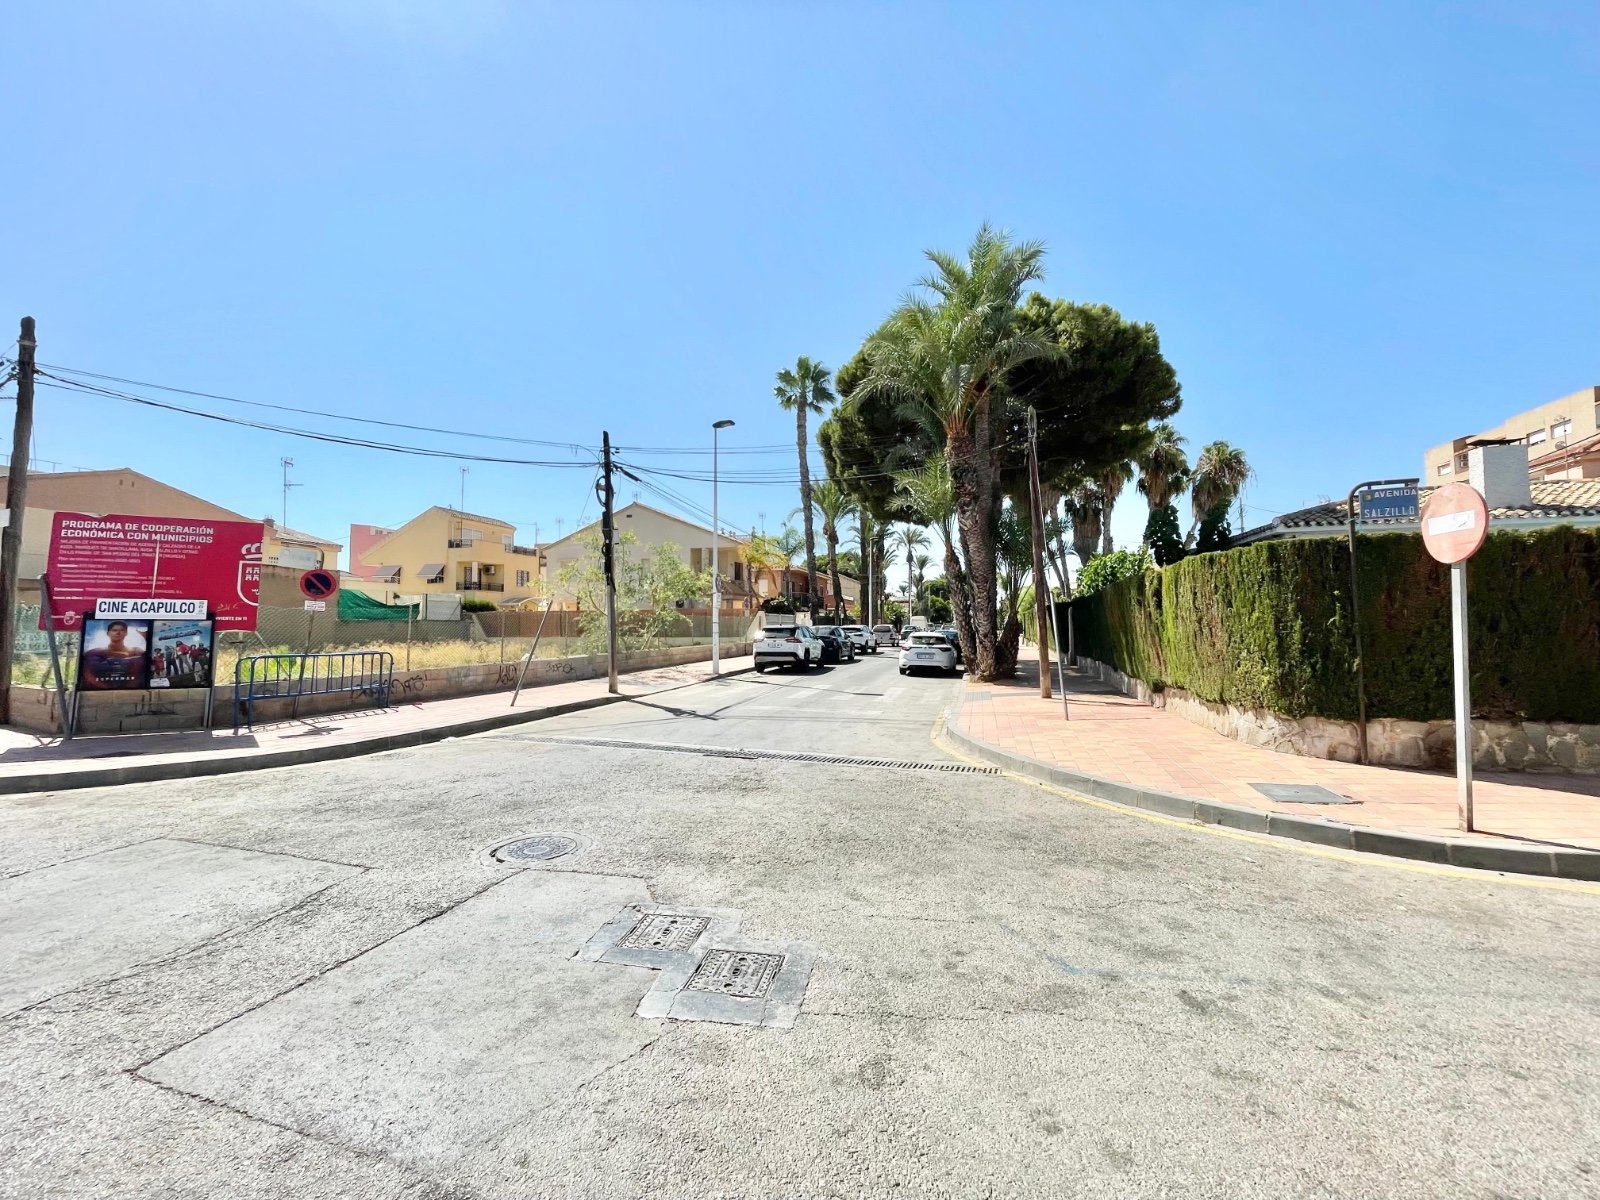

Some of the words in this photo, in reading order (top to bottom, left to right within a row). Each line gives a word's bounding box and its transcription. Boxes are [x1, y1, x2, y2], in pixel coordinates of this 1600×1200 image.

[1374, 489, 1417, 498] AVENIDA
[1364, 506, 1415, 518] SALZILLO
[62, 520, 122, 530] PROGRAMA
[125, 523, 139, 531] DE
[141, 523, 214, 535] COOPERACIÓN
[61, 528, 124, 539] ECONÓMICA
[127, 532, 149, 541] CON
[151, 533, 213, 544] MUNICIPIOS
[98, 601, 128, 613] CINE
[131, 601, 196, 614] ACAPULCO
